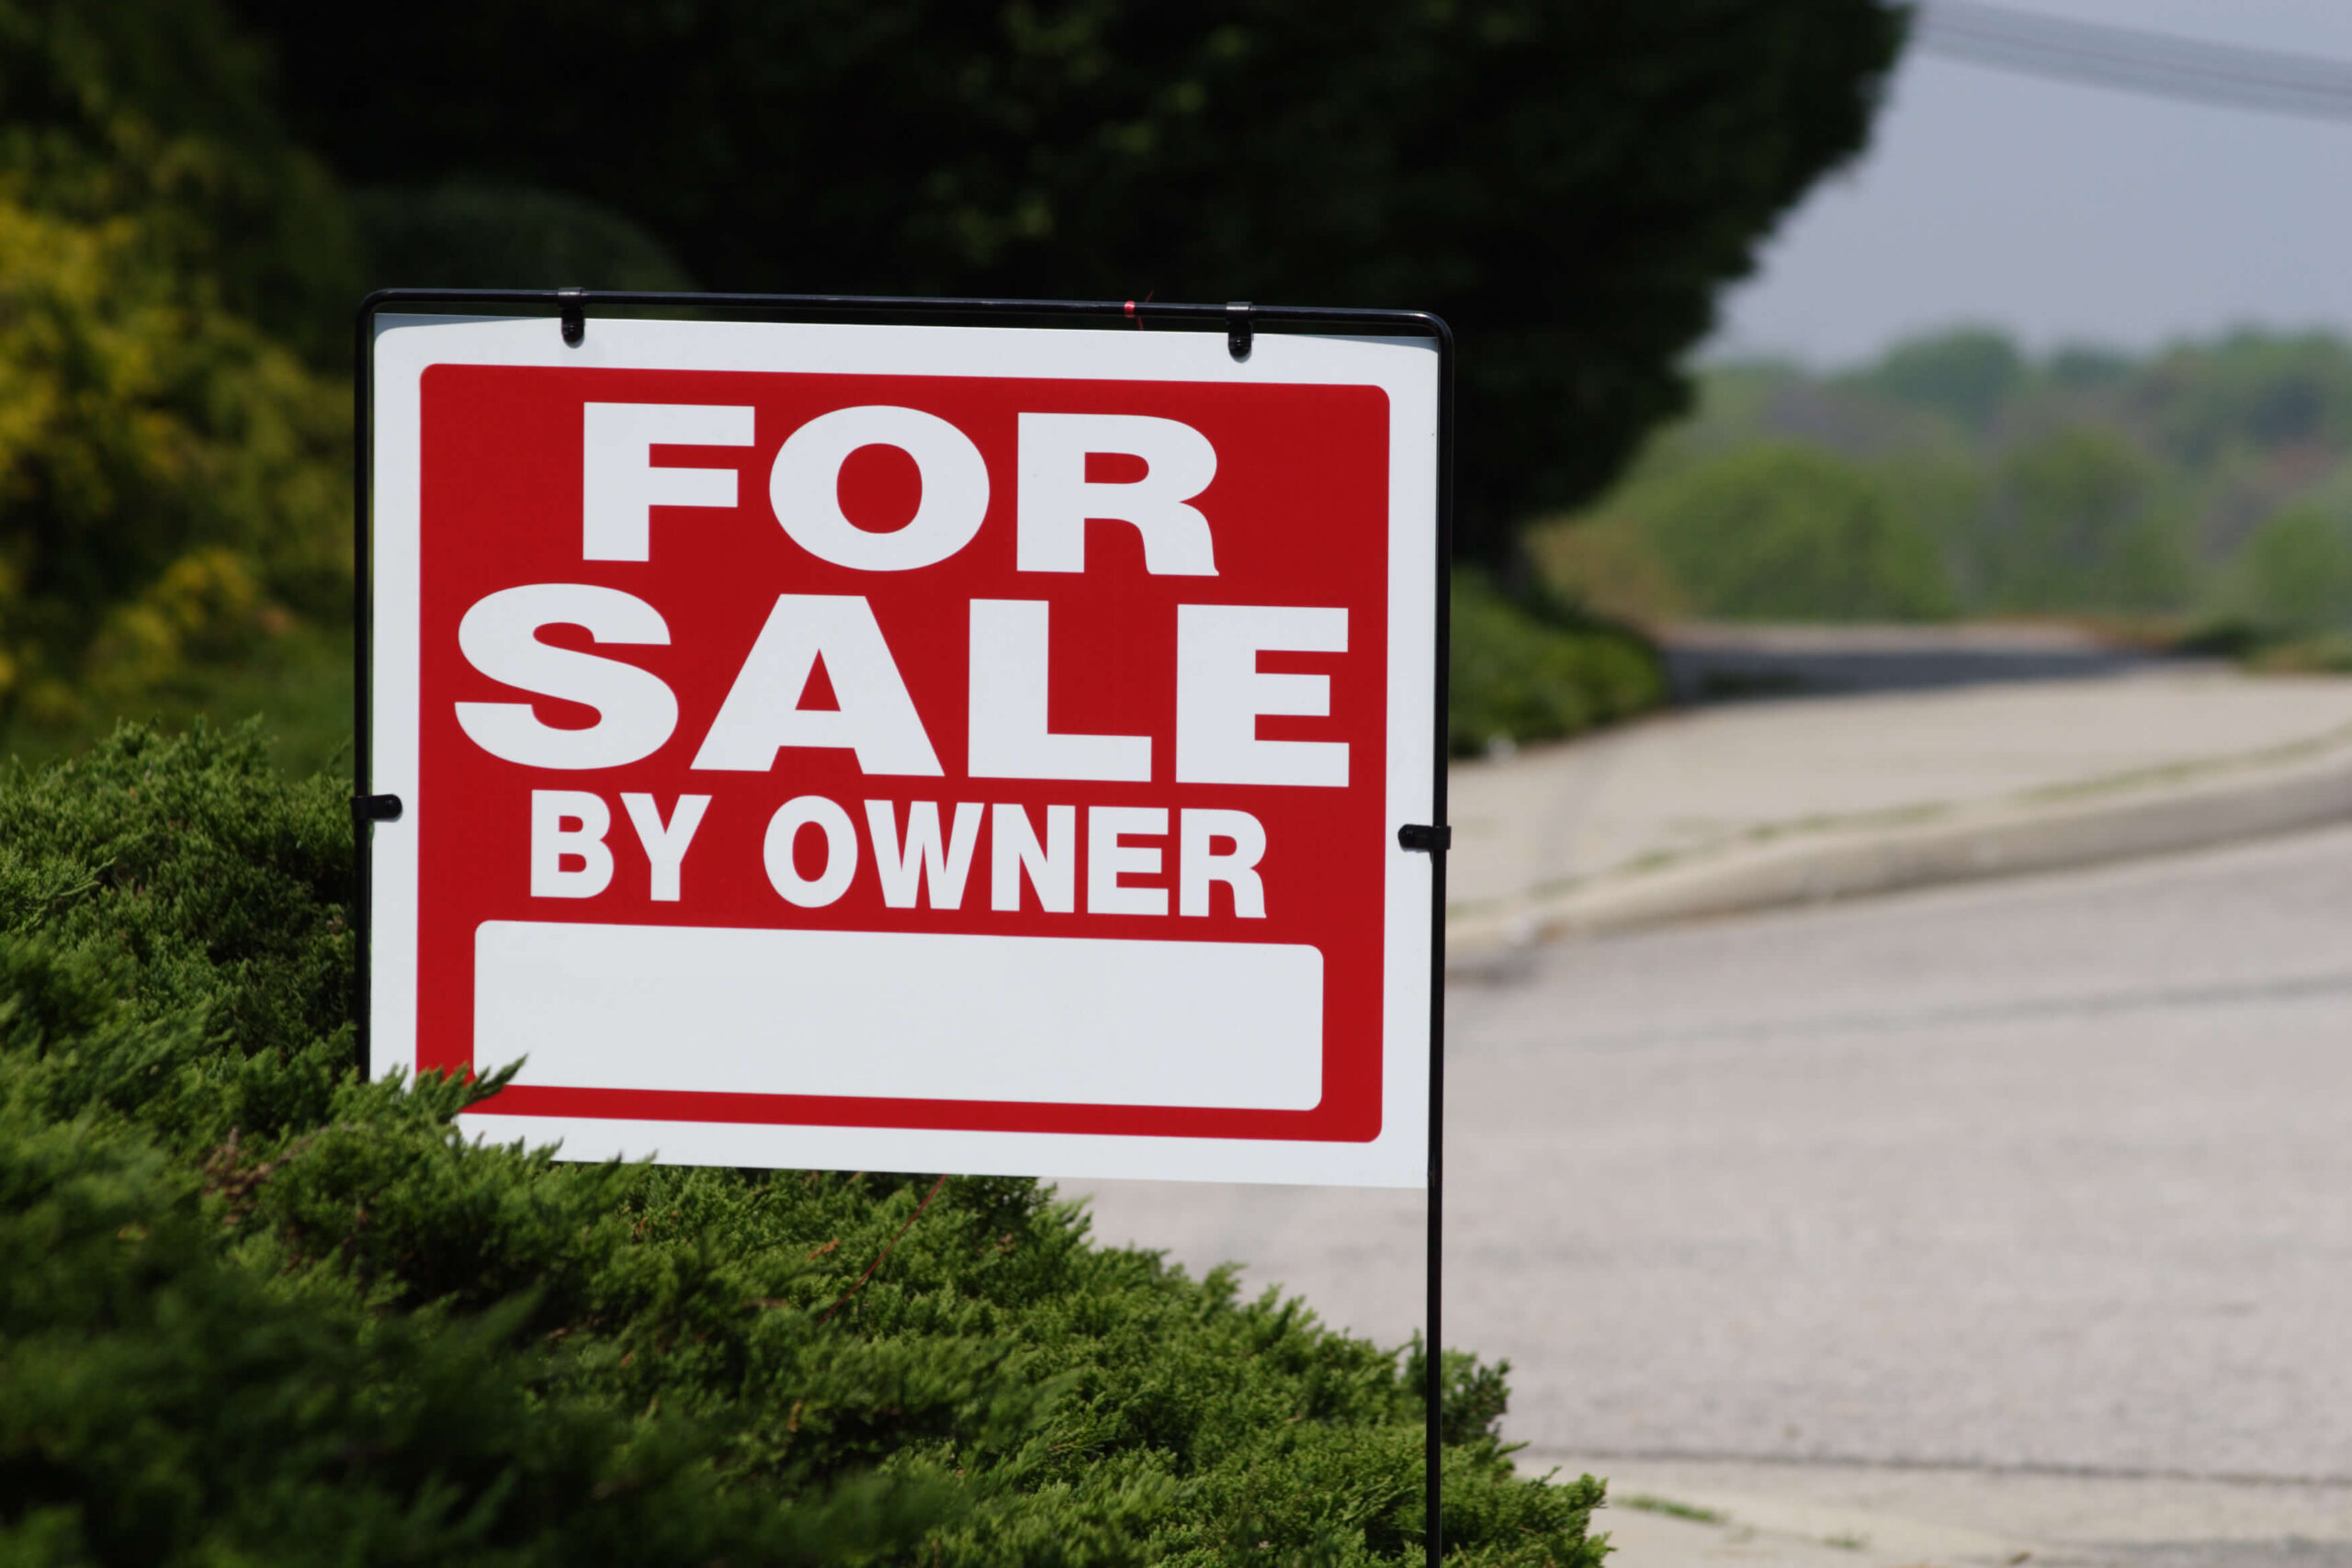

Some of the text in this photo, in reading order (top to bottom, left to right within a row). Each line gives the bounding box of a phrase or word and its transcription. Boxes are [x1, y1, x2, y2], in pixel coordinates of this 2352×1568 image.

[582, 401, 1220, 577] FOR
[454, 582, 1350, 788] SALE
[530, 789, 1267, 919] BY OWNER
